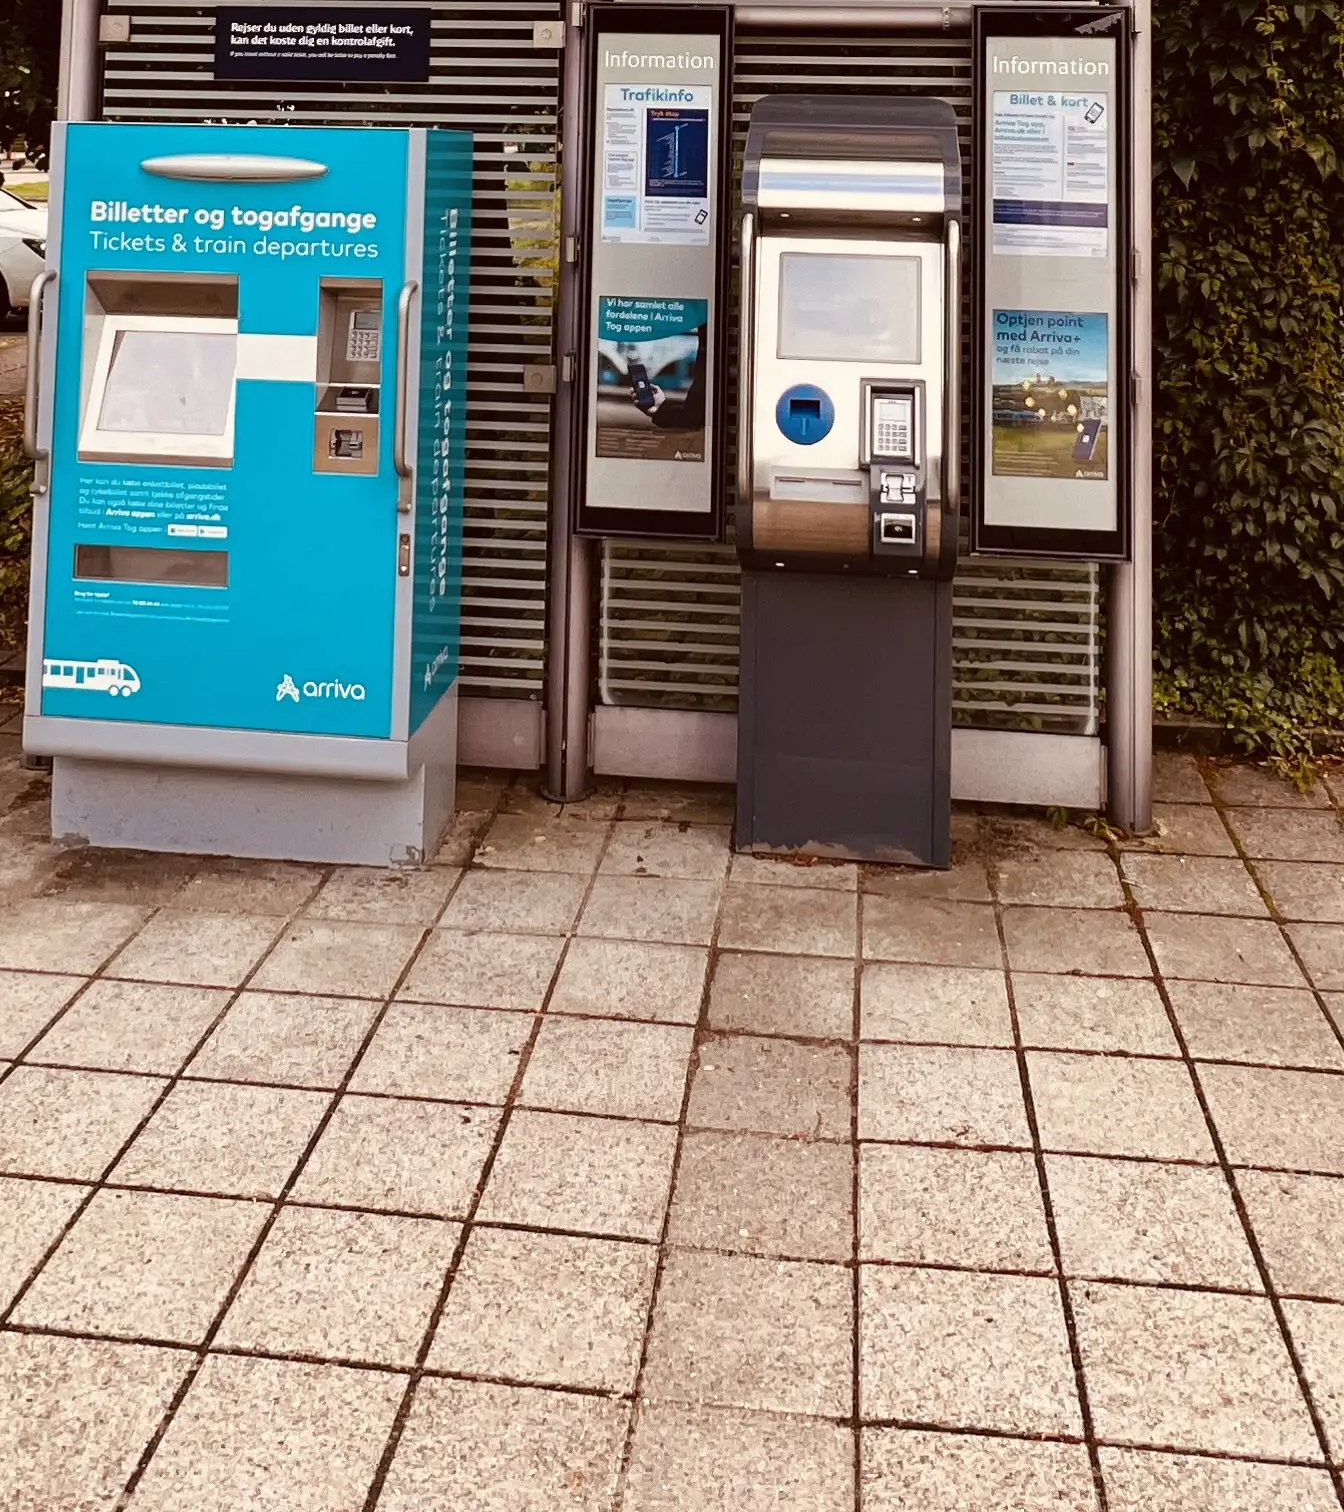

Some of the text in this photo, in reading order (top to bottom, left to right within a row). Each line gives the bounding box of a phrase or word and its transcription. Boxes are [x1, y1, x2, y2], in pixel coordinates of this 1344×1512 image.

[230, 23, 262, 34] Rejser
[263, 23, 277, 33] du
[279, 23, 304, 33] uden
[306, 24, 337, 35] gyldig
[339, 23, 364, 33] billet
[366, 24, 388, 34] eller
[230, 35, 396, 48] kan det koste dig en kontrolafgift.
[605, 50, 714, 68] Information
[993, 55, 1109, 76] Information
[621, 88, 694, 102] Trafikinfo
[1010, 94, 1088, 107] Billet & kort
[90, 200, 376, 233] Billetter og togafgange
[89, 230, 378, 260] Tickets & train departures
[438, 208, 449, 315] Tickets
[606, 298, 684, 311] Vi har samlet alle
[606, 310, 649, 320] fordelene
[654, 313, 683, 322] Arriva
[996, 313, 1084, 328] Optjen point
[606, 321, 652, 332] Tog appen
[997, 330, 1081, 343] med Arriva+
[996, 344, 1080, 355] og få rabat på din
[434, 357, 443, 428] train
[438, 208, 458, 596] Billetter og togafgange
[106, 508, 130, 516] Arriva
[429, 438, 441, 612] departures
[303, 678, 365, 700] arriva
